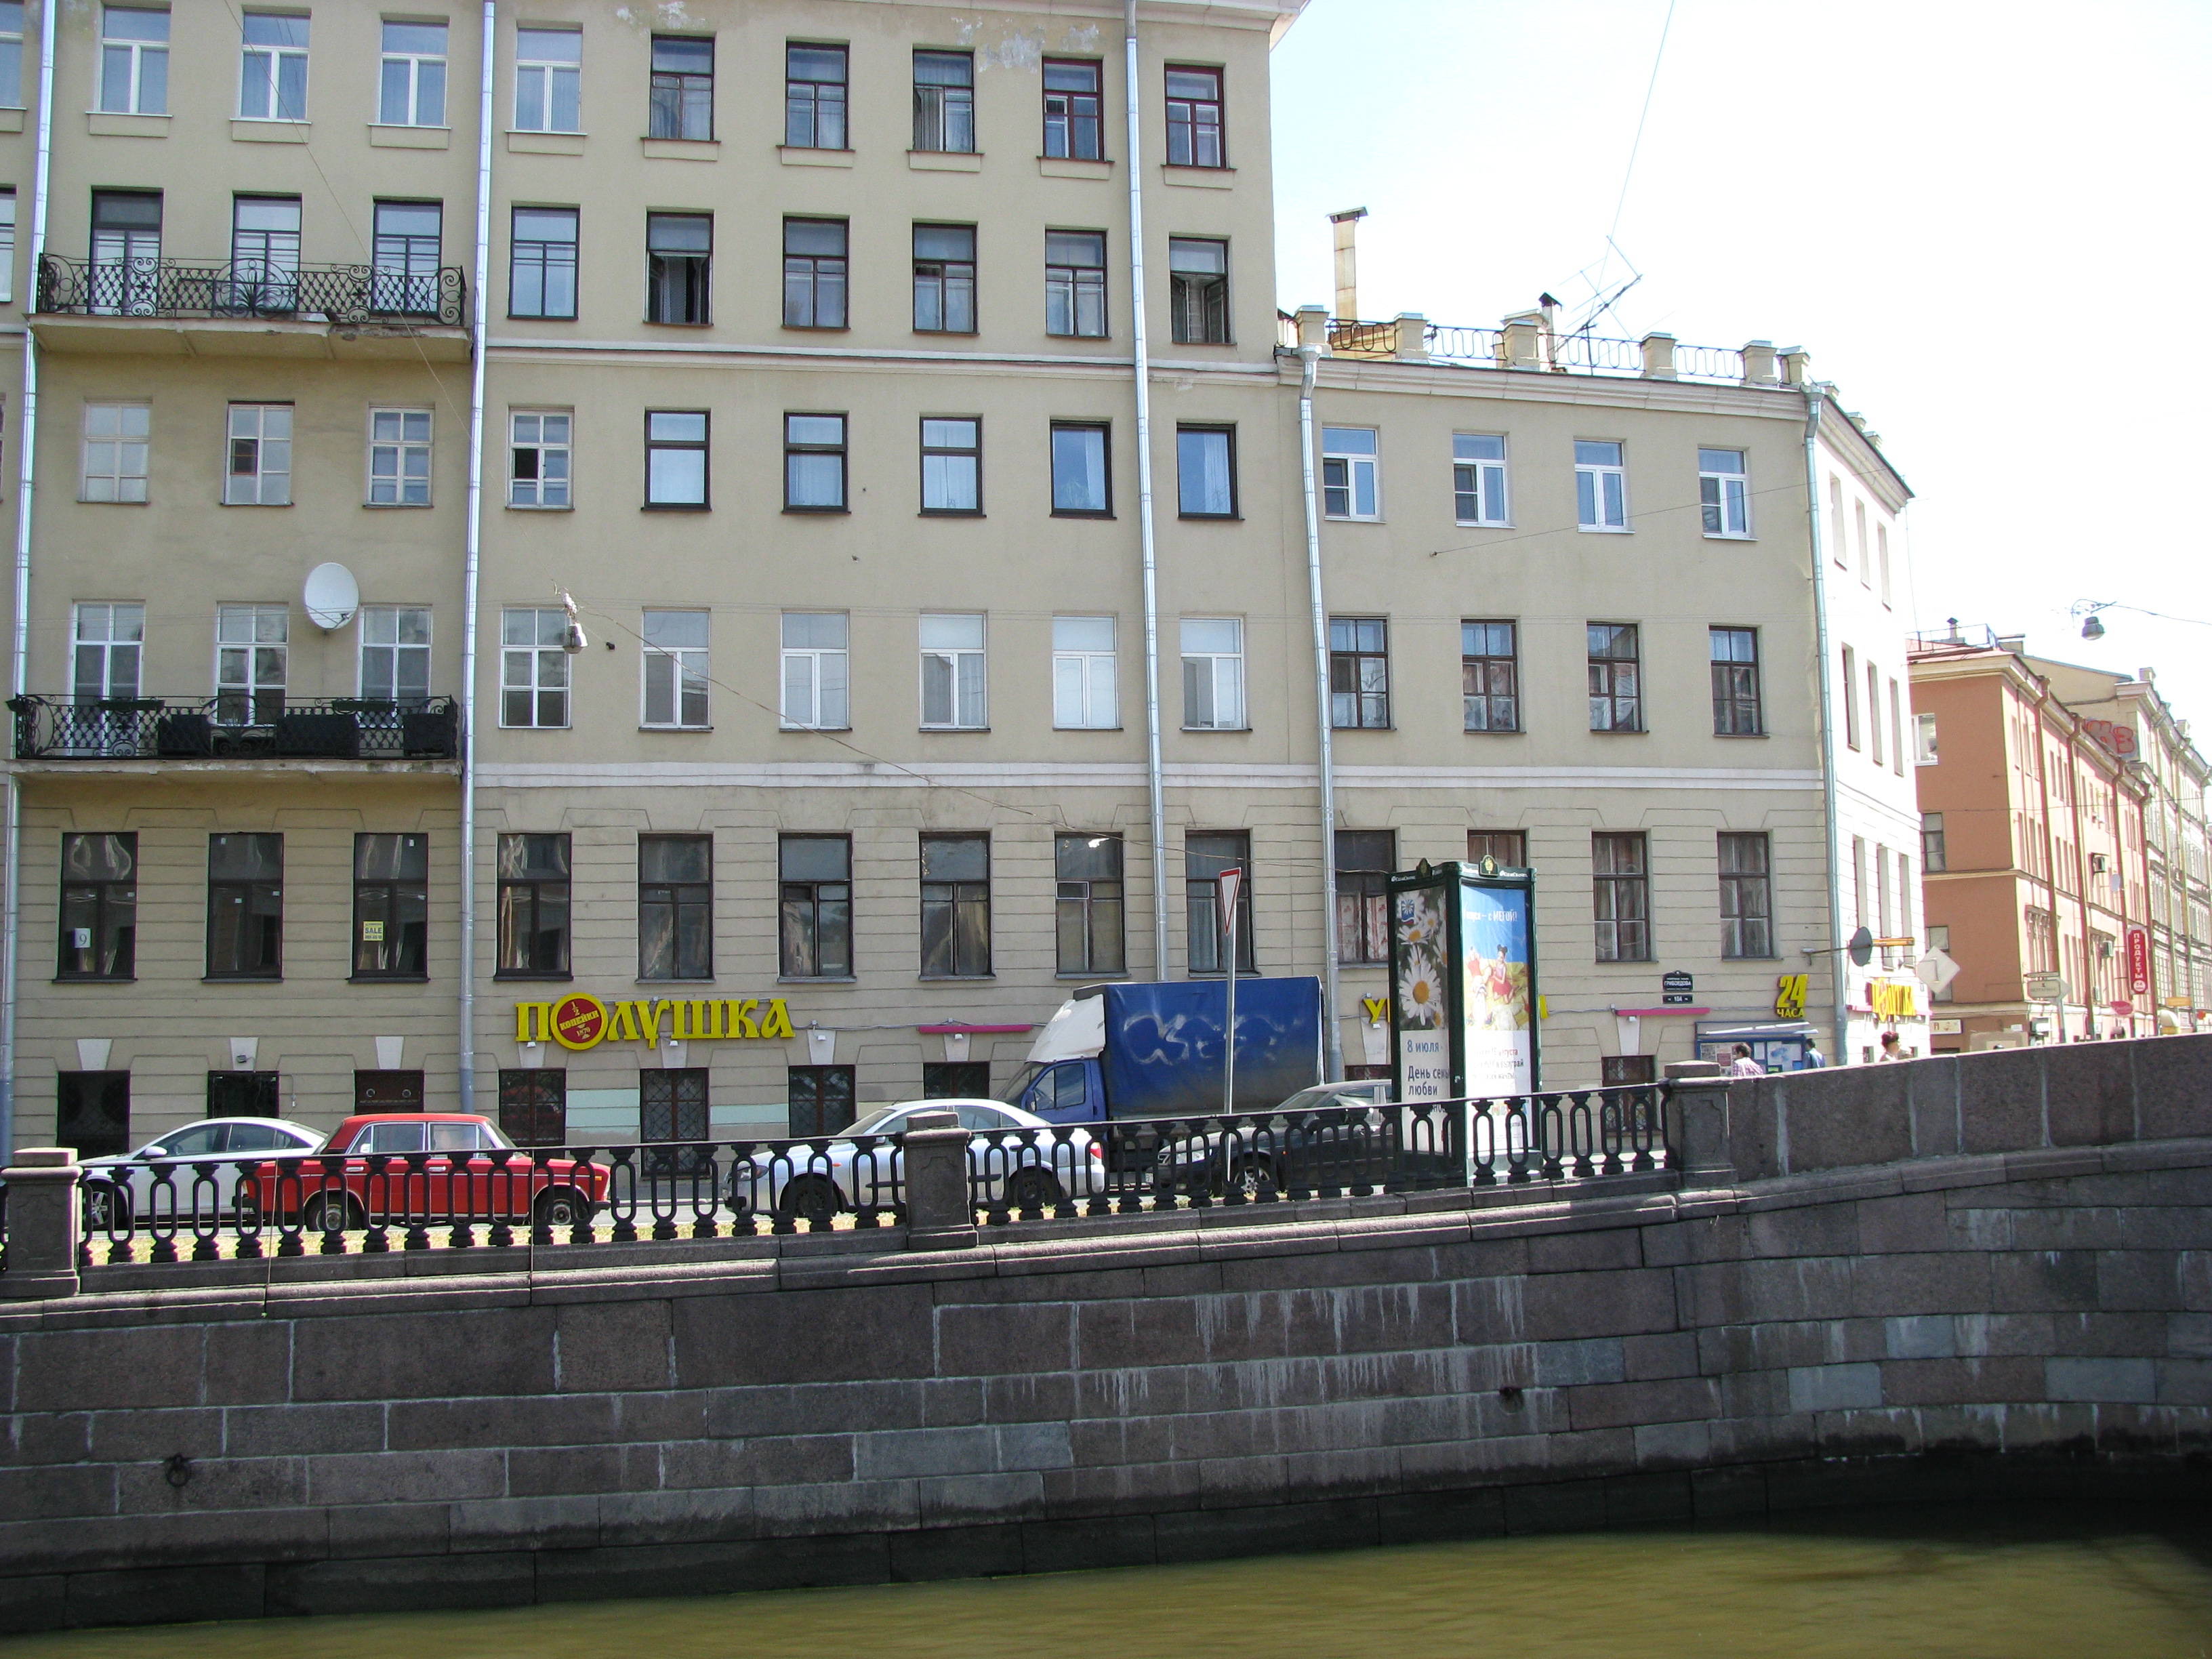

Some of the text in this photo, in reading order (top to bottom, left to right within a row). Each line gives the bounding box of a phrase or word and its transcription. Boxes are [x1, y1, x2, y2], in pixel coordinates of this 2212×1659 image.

[79, 934, 87, 946] 9
[2133, 933, 2143, 979] ПРОДУКТЫ
[1776, 974, 1808, 1008] 24
[515, 992, 796, 1050] ПОЛУШКА
[559, 1010, 599, 1031] КОПЕЙКИ
[1777, 1008, 1805, 1018] ЧАСА
[1407, 1040, 1439, 1052] 8 июля
[1408, 1065, 1431, 1082] День
[1408, 1081, 1438, 1095] любви
